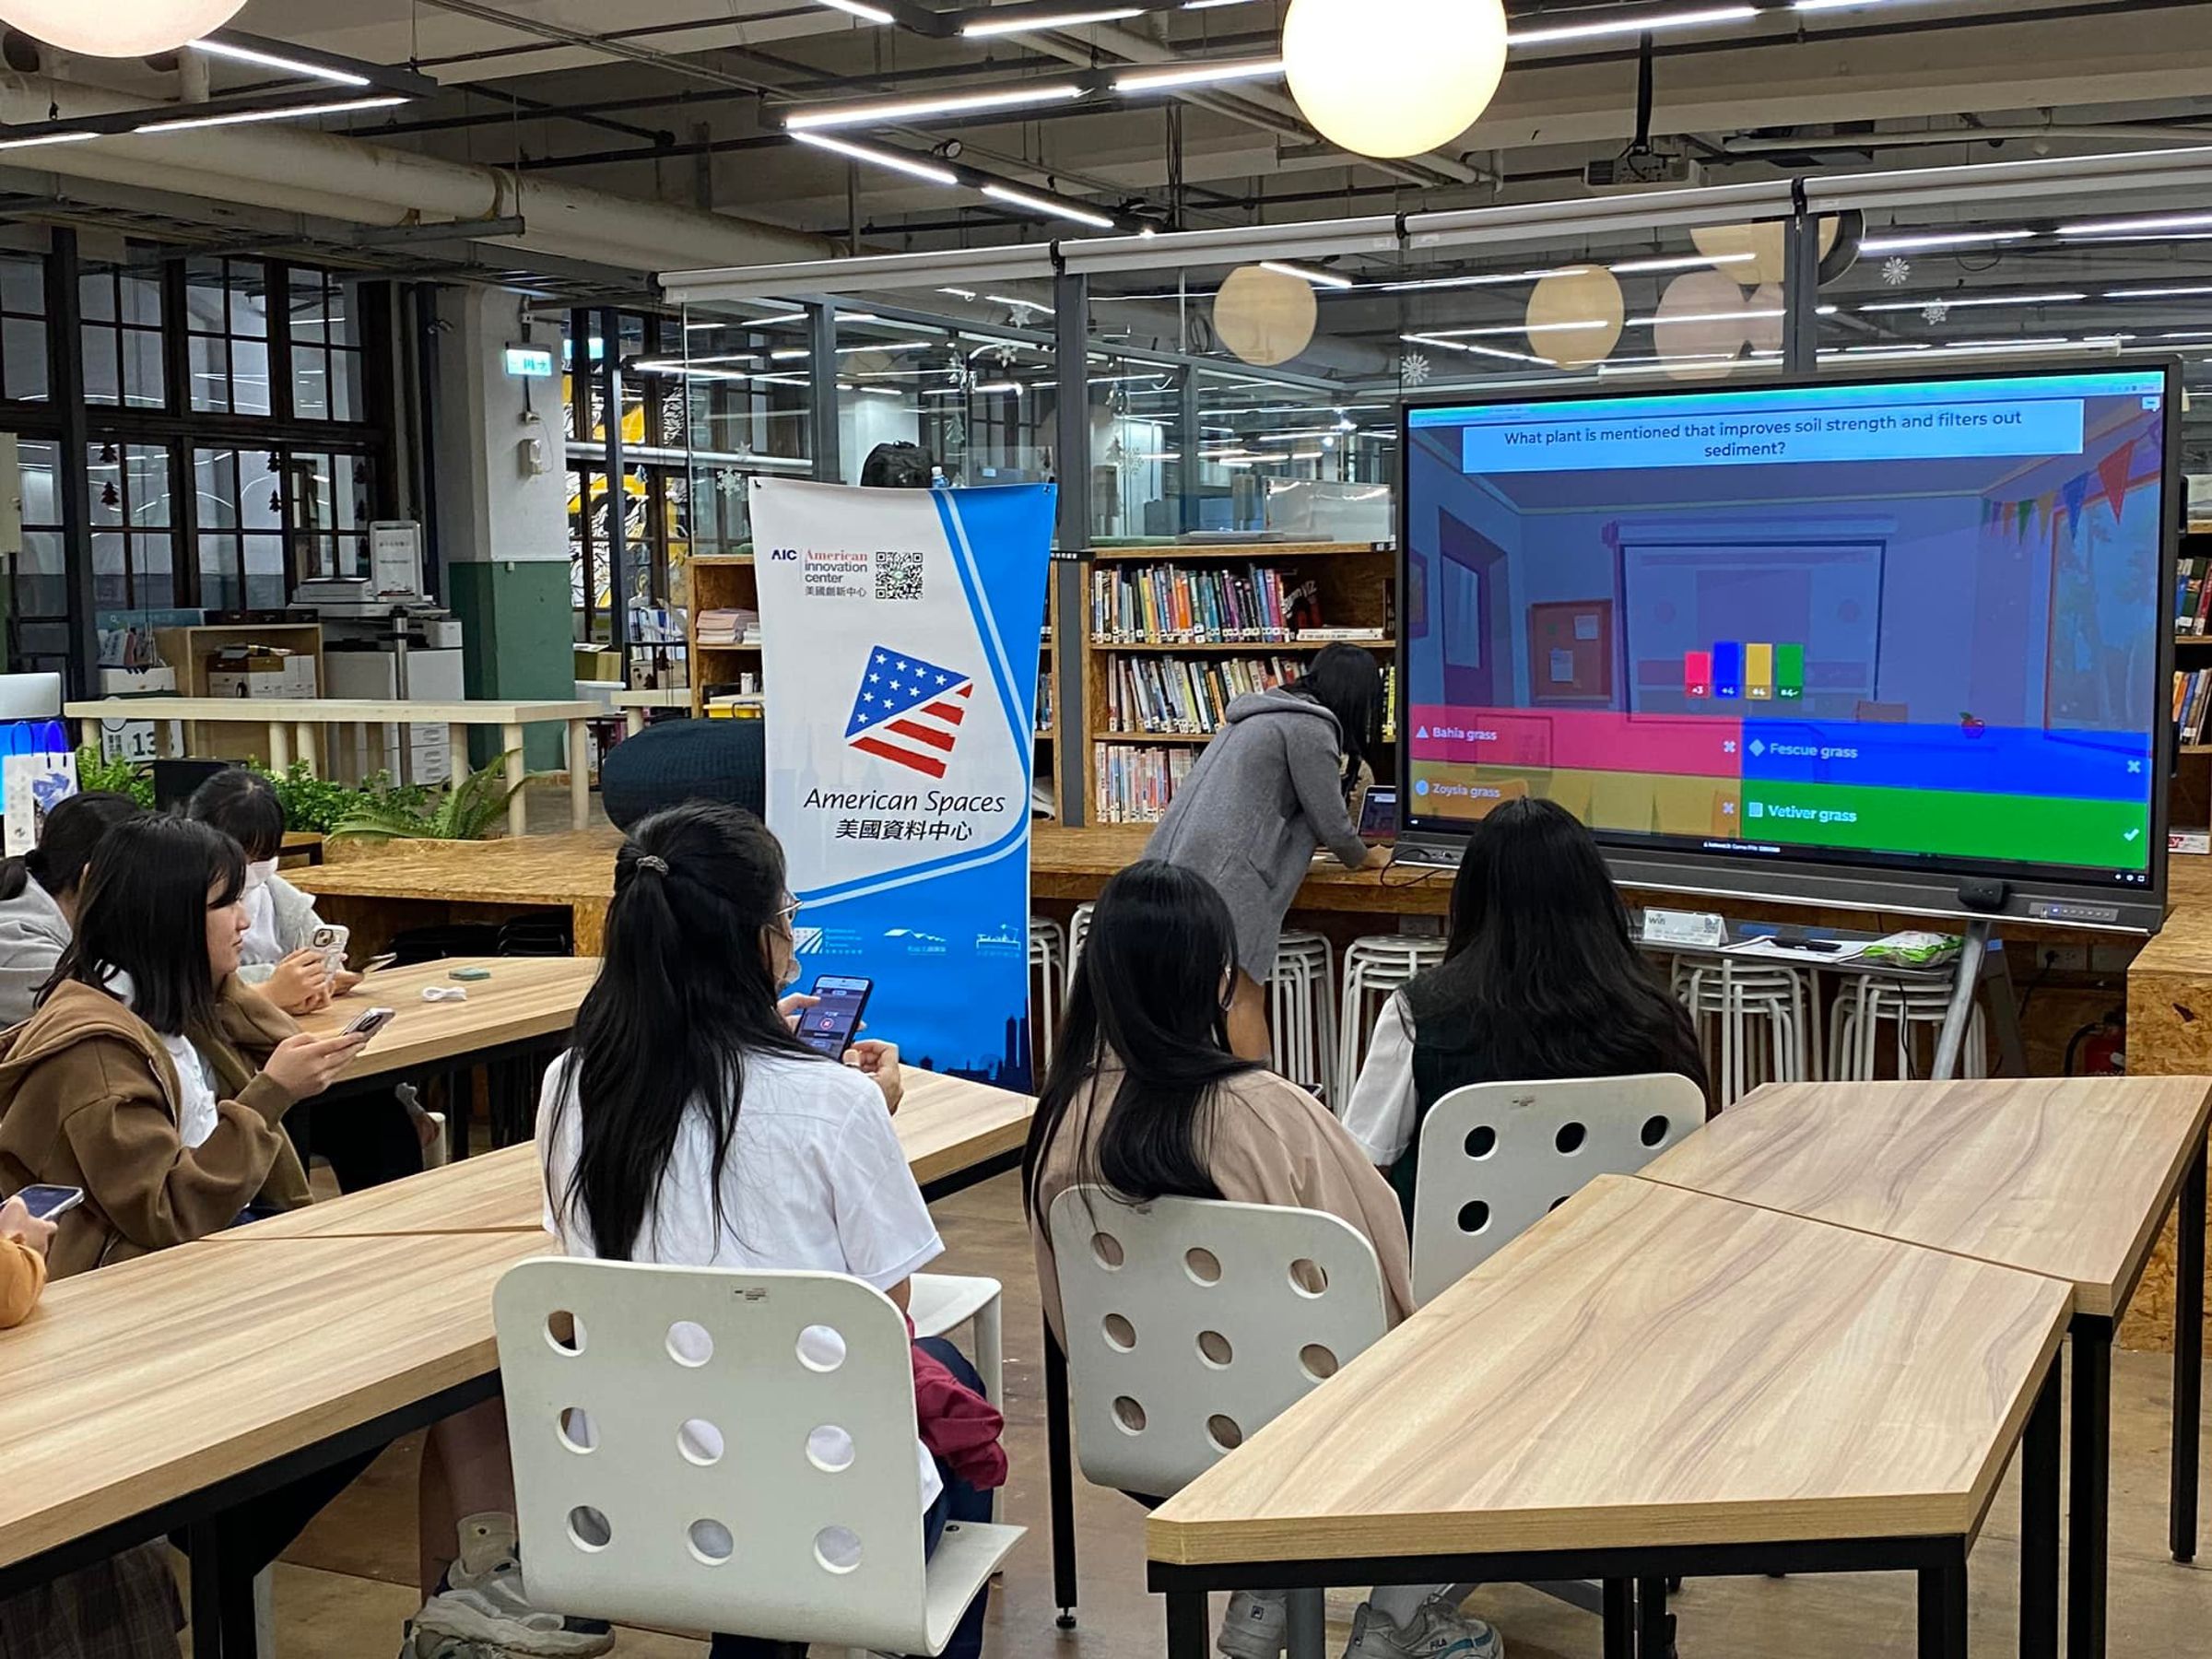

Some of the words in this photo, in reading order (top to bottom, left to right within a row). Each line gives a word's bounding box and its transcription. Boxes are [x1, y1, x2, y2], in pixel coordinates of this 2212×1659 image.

[1504, 432, 1542, 444] What
[1546, 429, 1581, 446] plant
[1585, 428, 1596, 441] is
[1600, 424, 1680, 441] mentioned
[1685, 423, 1715, 438] that
[1720, 420, 1791, 437] improves
[1794, 418, 1822, 433] soil
[1826, 416, 1897, 432] strength
[1901, 414, 1934, 429] and
[1938, 412, 1988, 427] filters
[1993, 411, 2022, 425] out
[1704, 441, 1786, 457] sediment?
[771, 549, 797, 560] AIC
[806, 549, 867, 561] American
[805, 560, 867, 572] innovation
[805, 572, 843, 583] center
[1432, 726, 1465, 738] Bahia
[1466, 730, 1498, 741] grass
[1770, 743, 1818, 756] Fescue
[1820, 747, 1858, 759] grass
[1432, 782, 1467, 796] Zoysia
[1470, 786, 1500, 798] grass
[804, 788, 917, 812] American
[924, 790, 1006, 816] Spaces
[1768, 805, 1818, 819] Vetiver
[1819, 809, 1857, 823] grass
[835, 818, 972, 841] 美國資料中心
